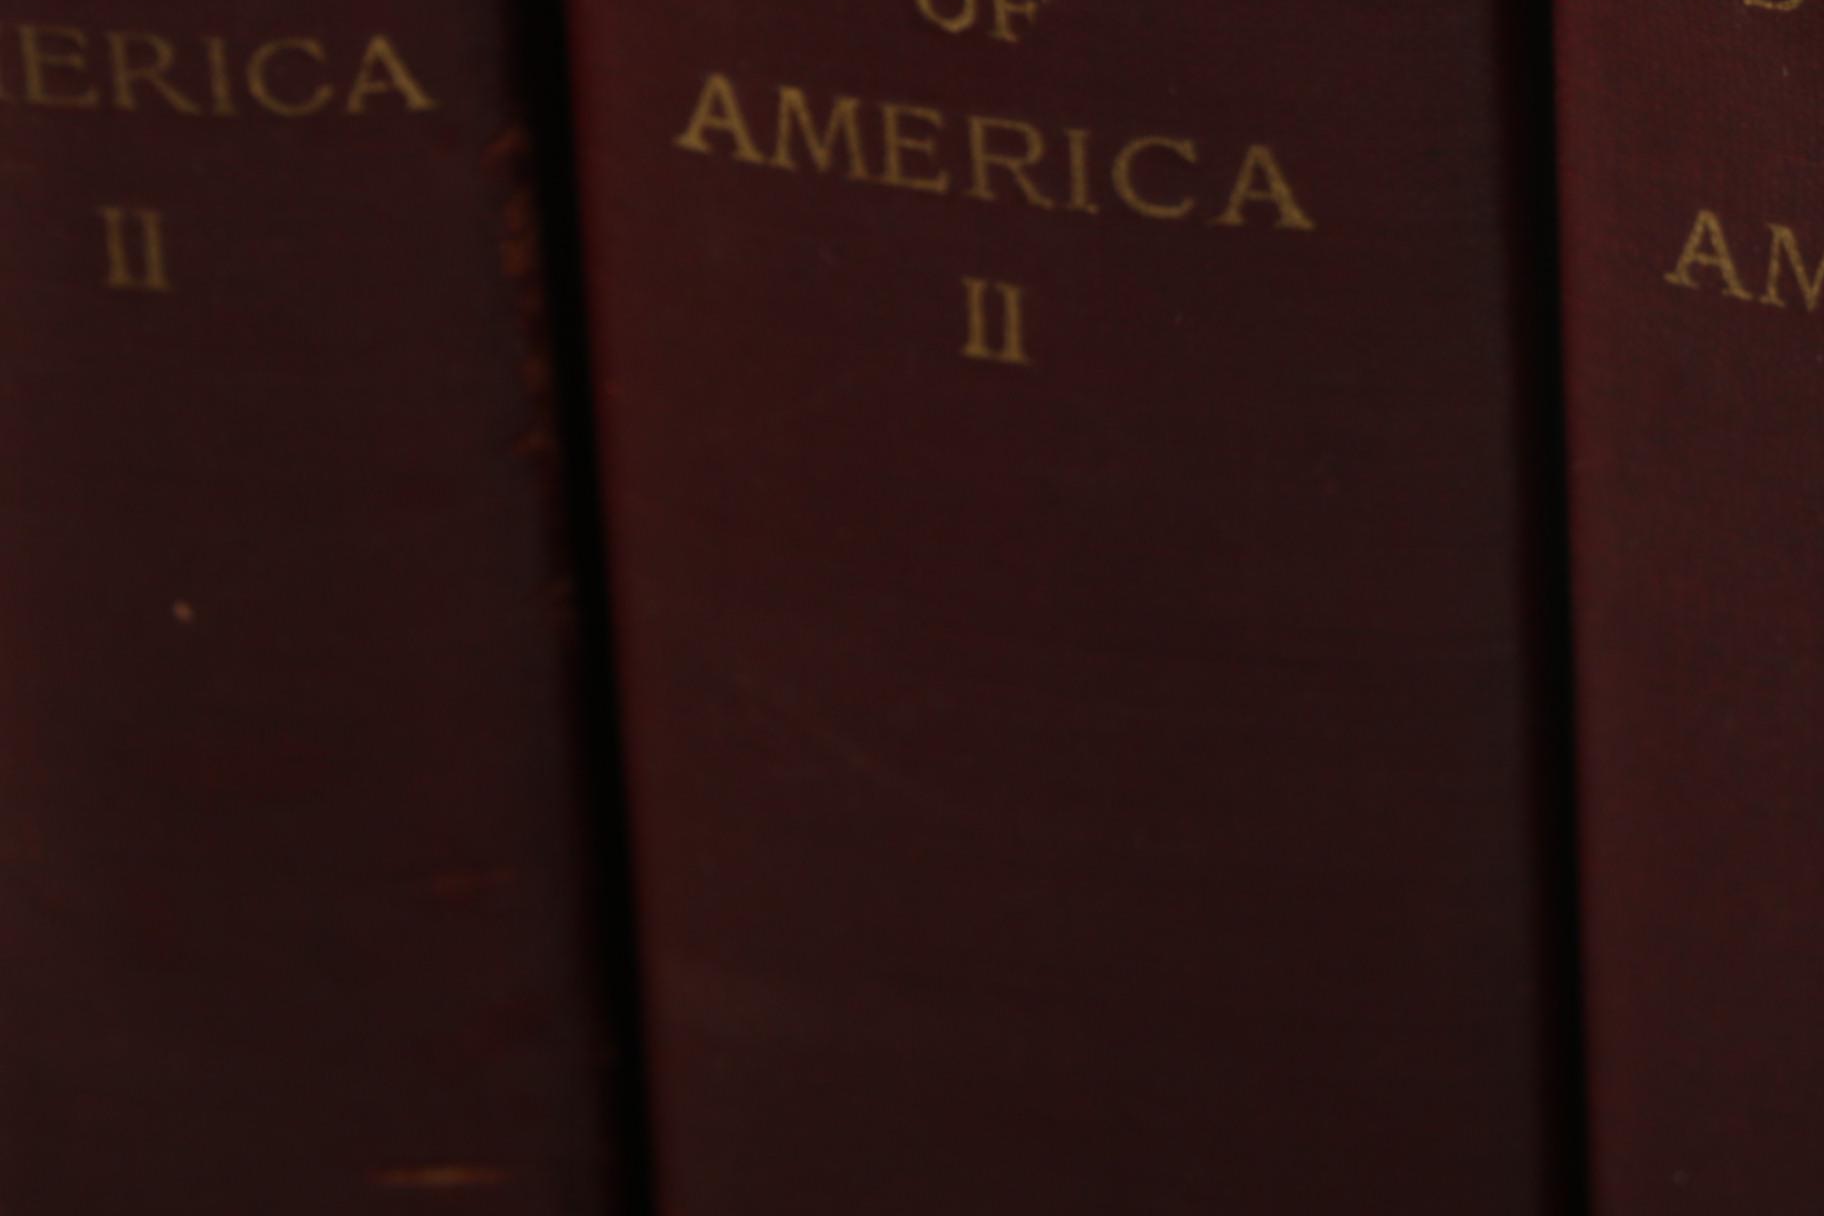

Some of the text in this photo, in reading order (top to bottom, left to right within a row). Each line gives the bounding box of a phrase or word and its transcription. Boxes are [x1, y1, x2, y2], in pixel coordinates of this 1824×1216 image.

[0, 21, 442, 116] ERICA
[674, 71, 1318, 232] AMERICA
[98, 206, 171, 292] II
[960, 275, 1032, 365] II
